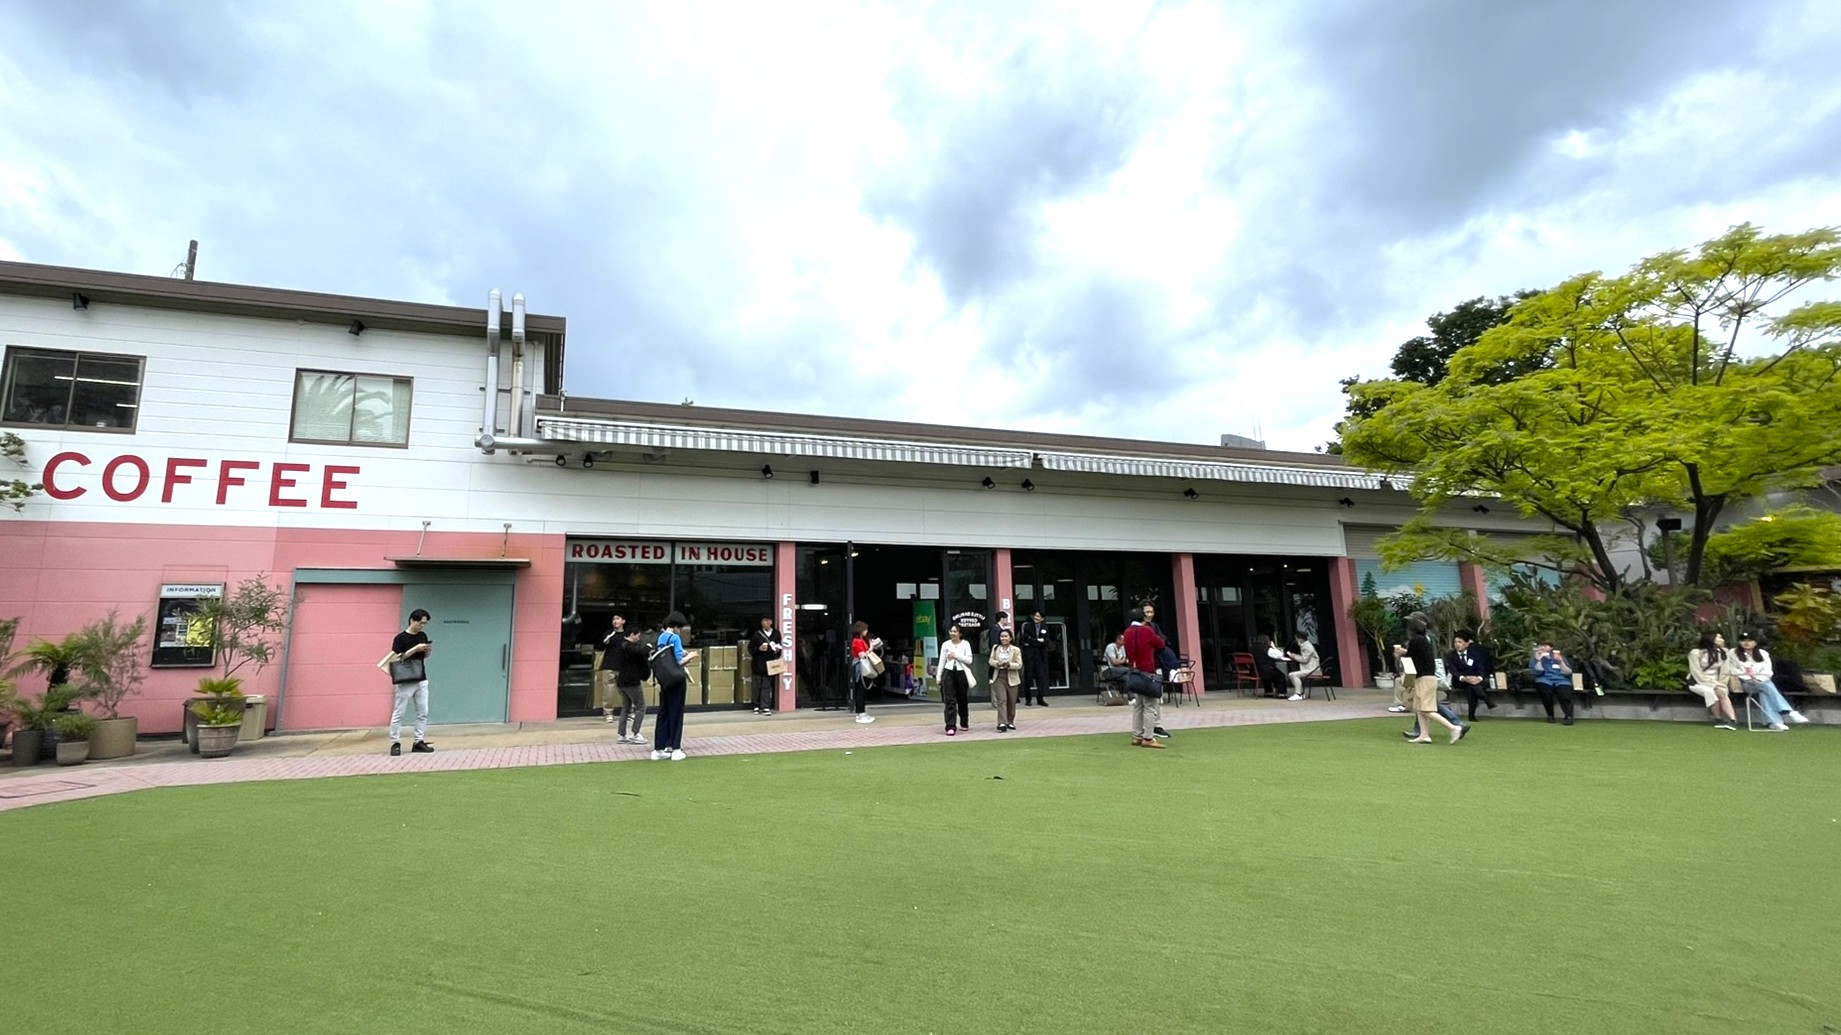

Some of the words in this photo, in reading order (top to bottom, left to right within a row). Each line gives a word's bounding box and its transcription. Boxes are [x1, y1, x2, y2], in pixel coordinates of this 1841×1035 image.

[42, 451, 361, 509] COFFEE
[572, 545, 665, 560] ROASTED
[681, 547, 700, 561] IN
[707, 547, 768, 562] HOUSE
[782, 593, 793, 691] FRESHY
